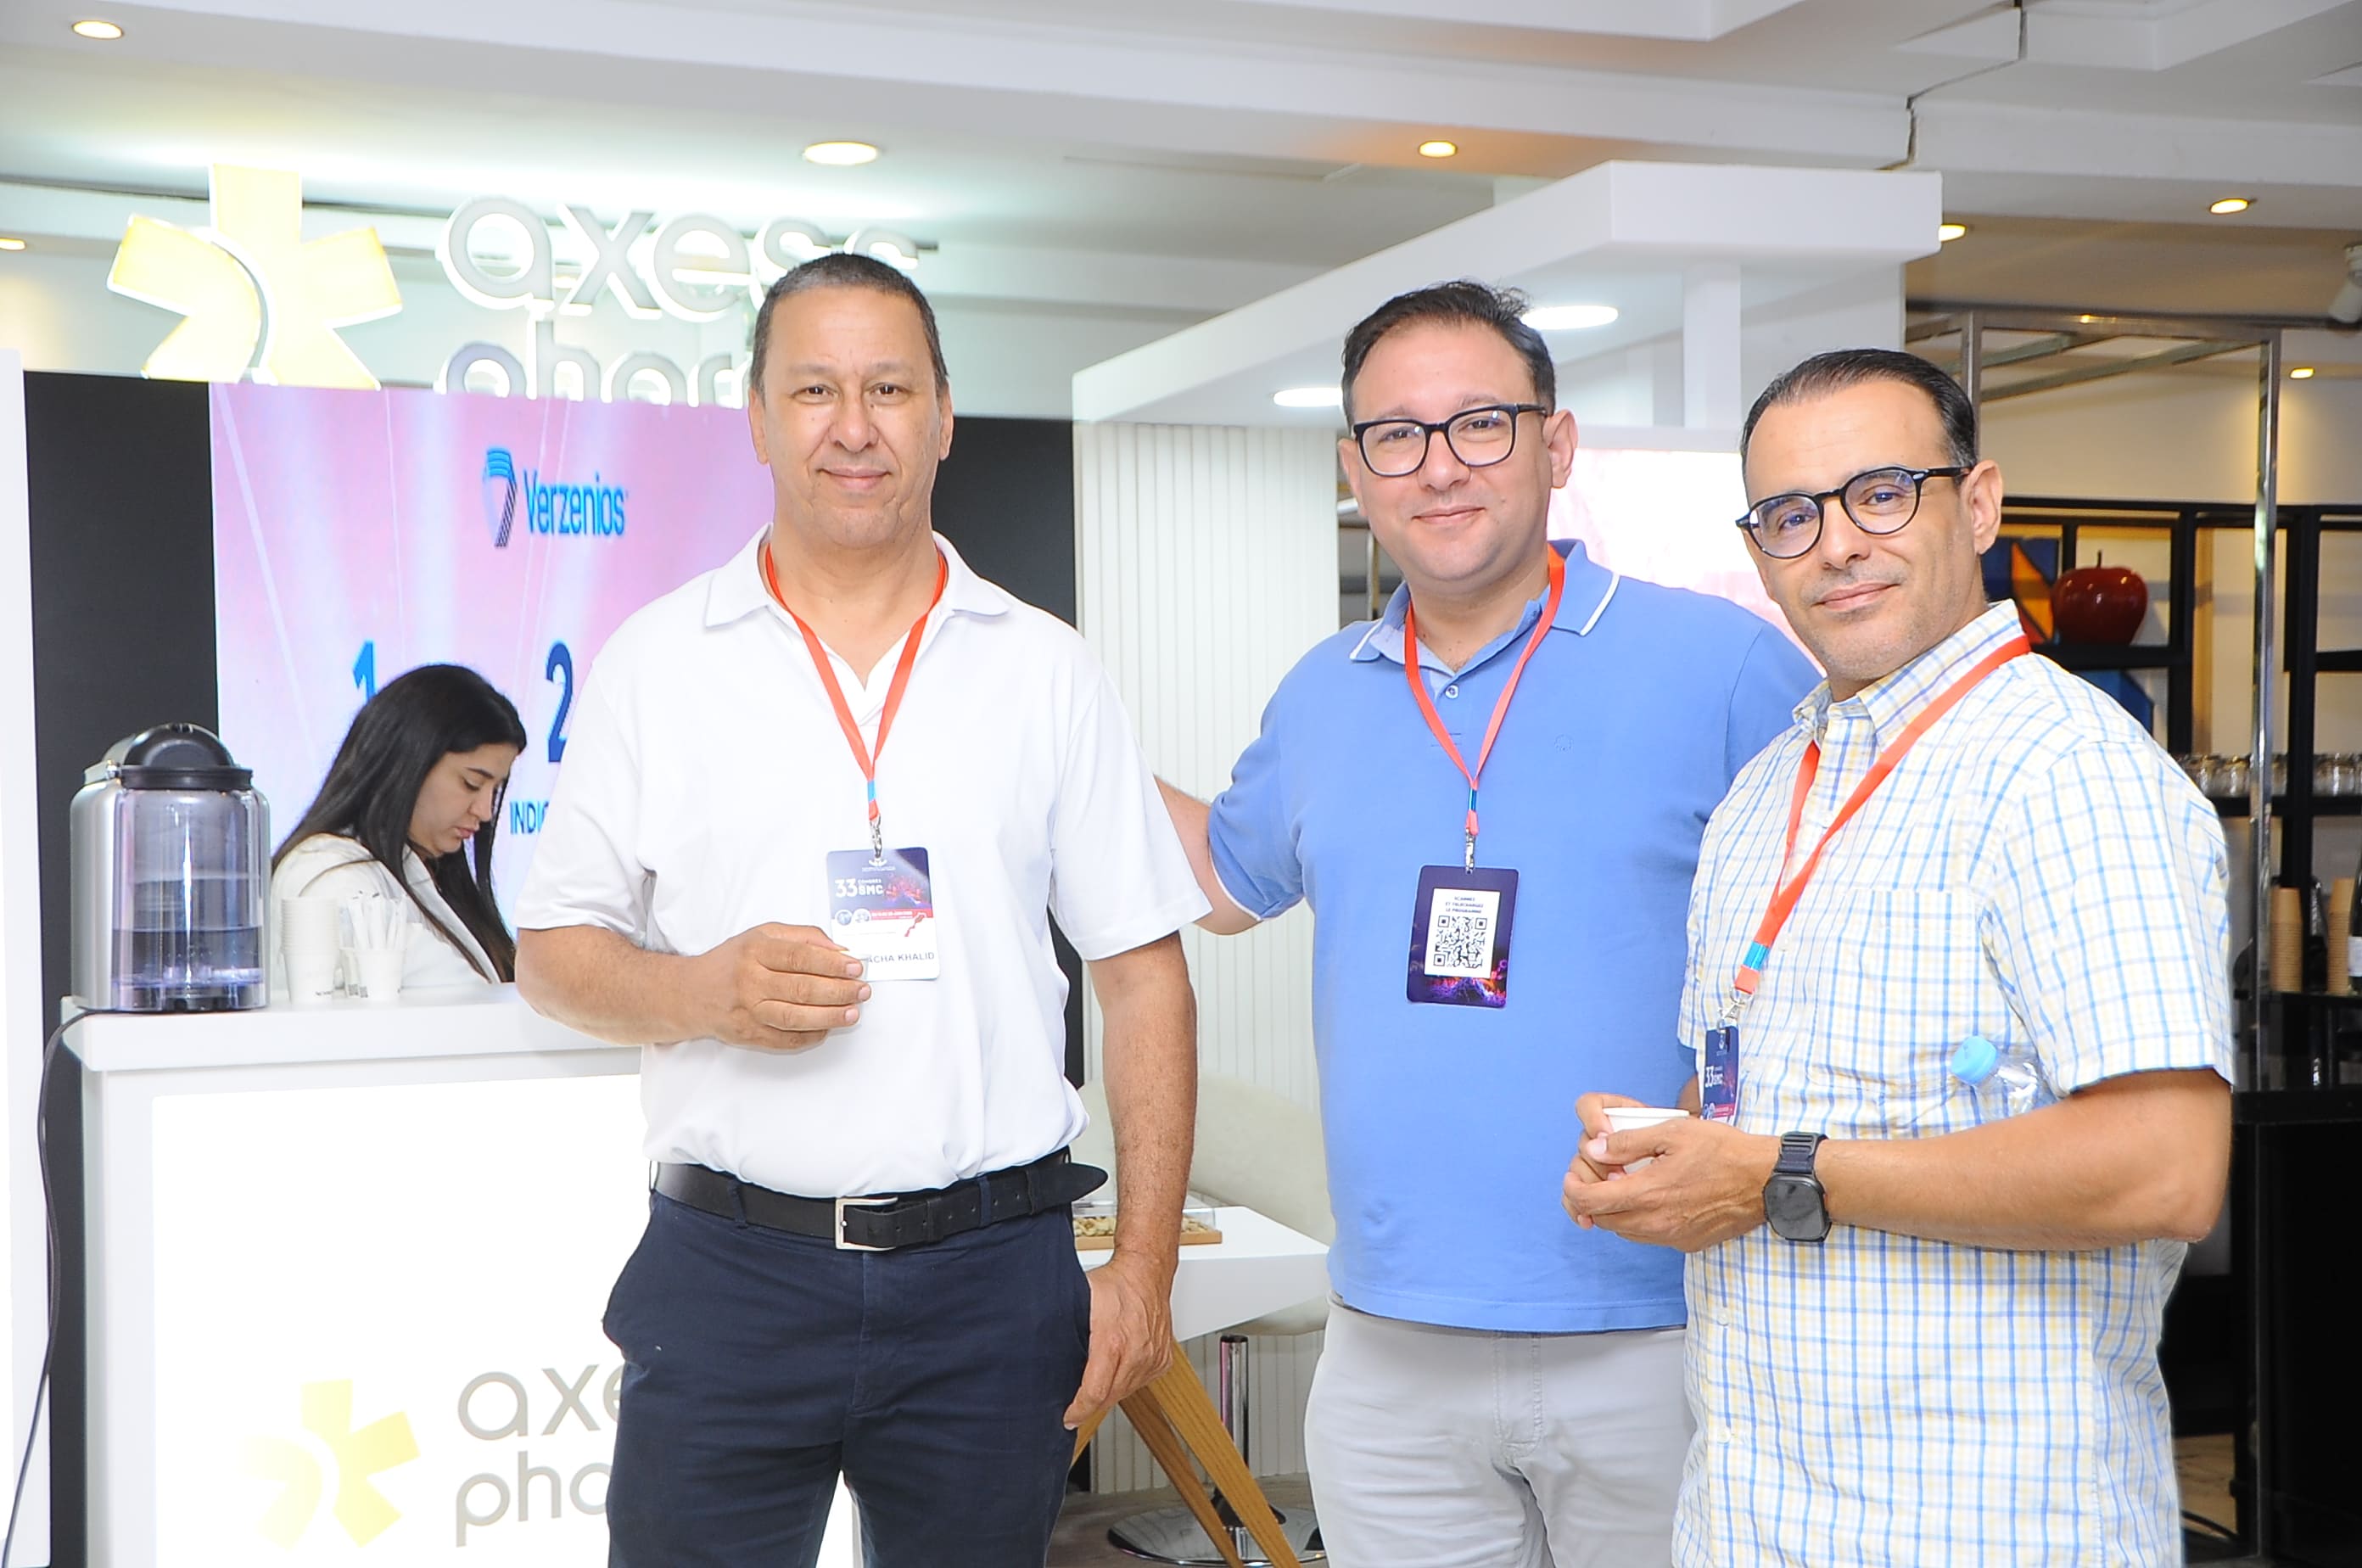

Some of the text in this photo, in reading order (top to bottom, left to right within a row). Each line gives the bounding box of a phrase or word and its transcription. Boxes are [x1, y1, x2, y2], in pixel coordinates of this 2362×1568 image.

[523, 469, 625, 536] Verzenios
[546, 641, 573, 763] 2
[835, 878, 858, 897] 33
[898, 952, 935, 961] KHALID
